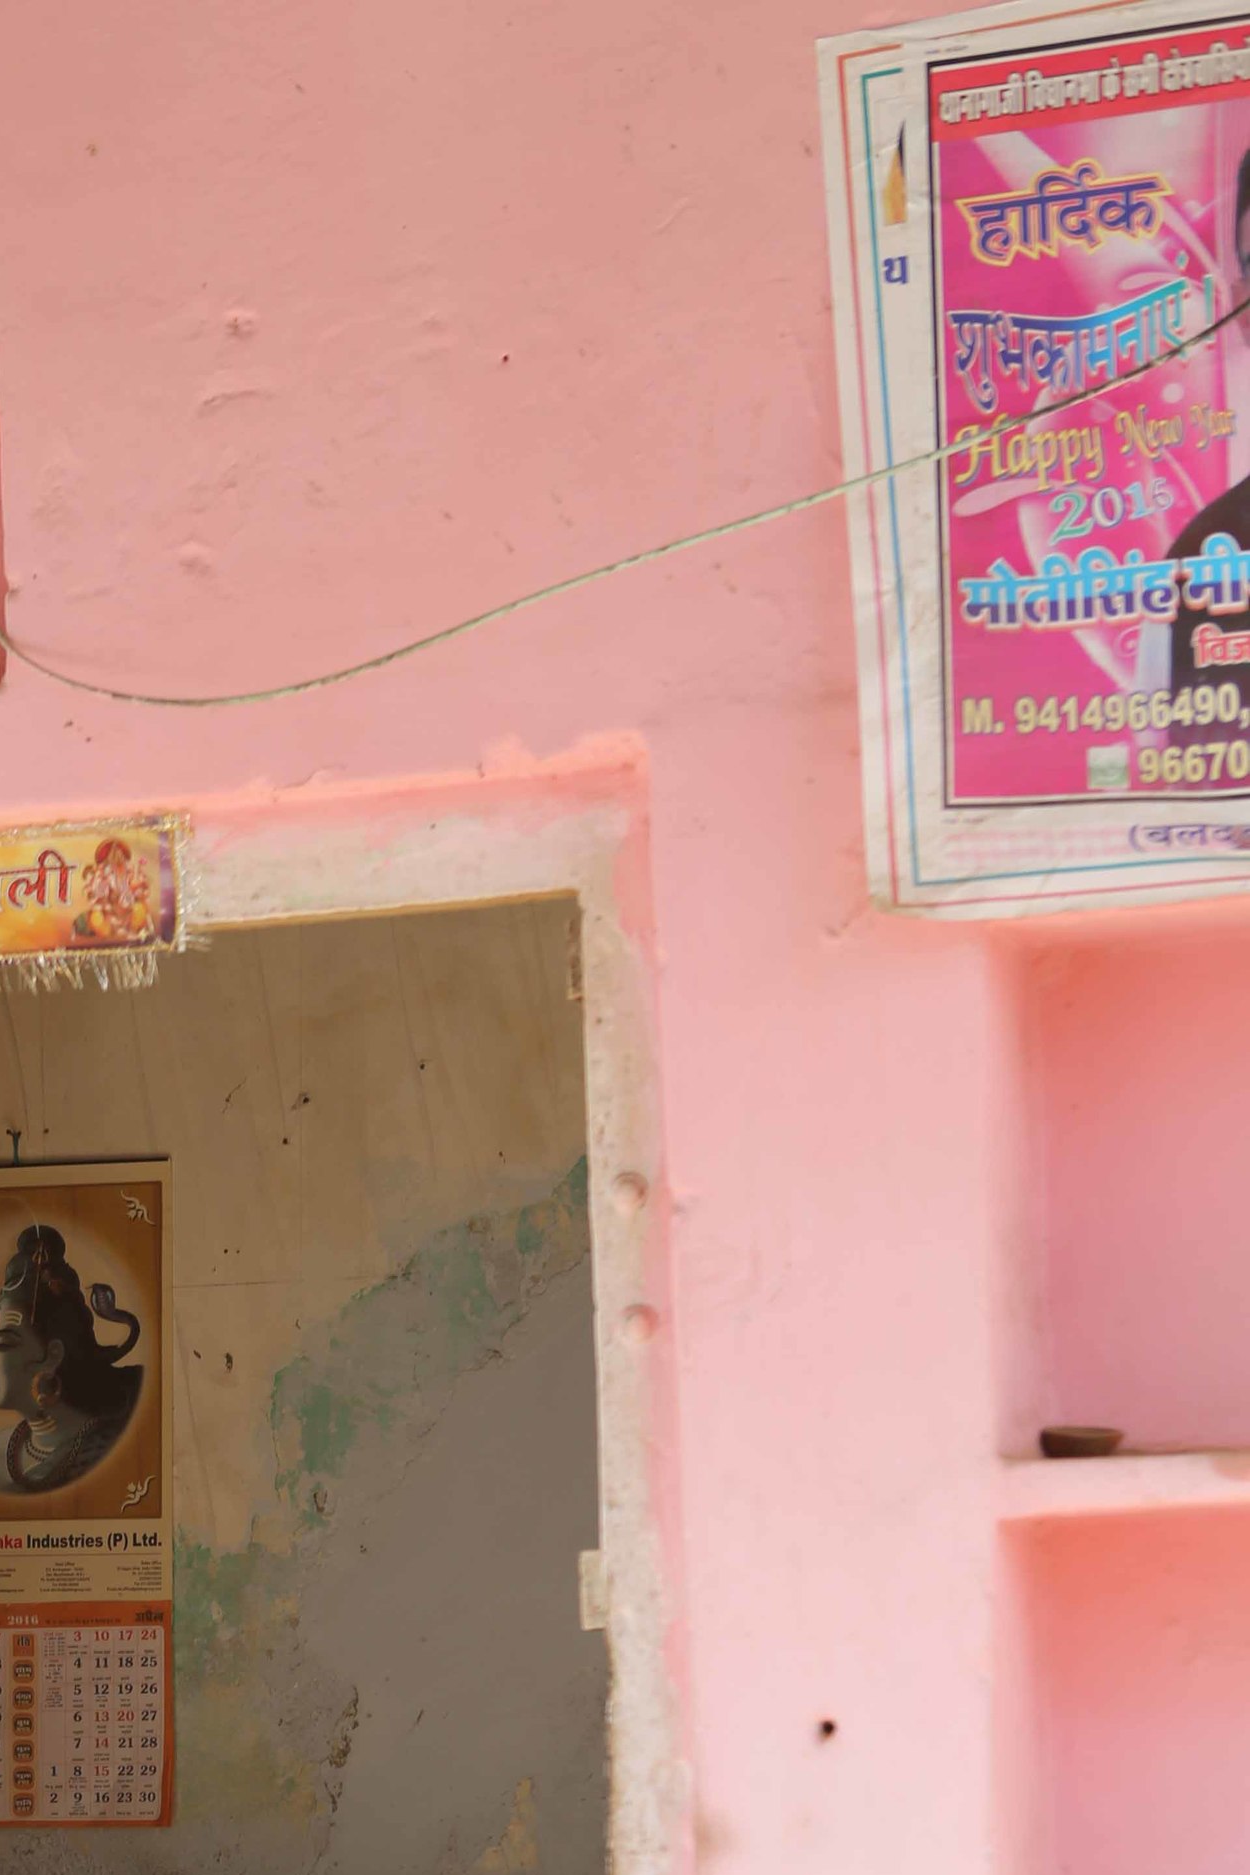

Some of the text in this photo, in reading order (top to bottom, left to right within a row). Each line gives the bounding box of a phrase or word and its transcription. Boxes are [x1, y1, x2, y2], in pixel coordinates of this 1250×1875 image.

[1102, 56, 1122, 100] के
[959, 161, 1170, 262] हार्दिक
[953, 413, 1104, 491] Happy
[1116, 404, 1183, 455] New
[1051, 477, 1174, 545] 2015
[960, 547, 1178, 628] मोतीसिंह
[962, 696, 1004, 735] M.
[26, 1532, 103, 1549] Industries
[107, 1532, 128, 1550] (P)
[132, 1532, 162, 1547] Ltd.
[7, 1615, 39, 1626] 2016
[73, 1655, 158, 1669] 4 11 18 25
[73, 1682, 158, 1696] 5 12 19 26
[73, 1710, 83, 1722] 6
[141, 1709, 158, 1722] 27
[73, 1737, 82, 1750] 7
[118, 1737, 134, 1749] 21
[140, 1736, 158, 1748] 28
[51, 1765, 57, 1777] 1
[73, 1765, 82, 1777] 8
[117, 1764, 134, 1777] 22
[140, 1764, 157, 1777] 29
[49, 1791, 158, 1804] 2 9 16 23 30
